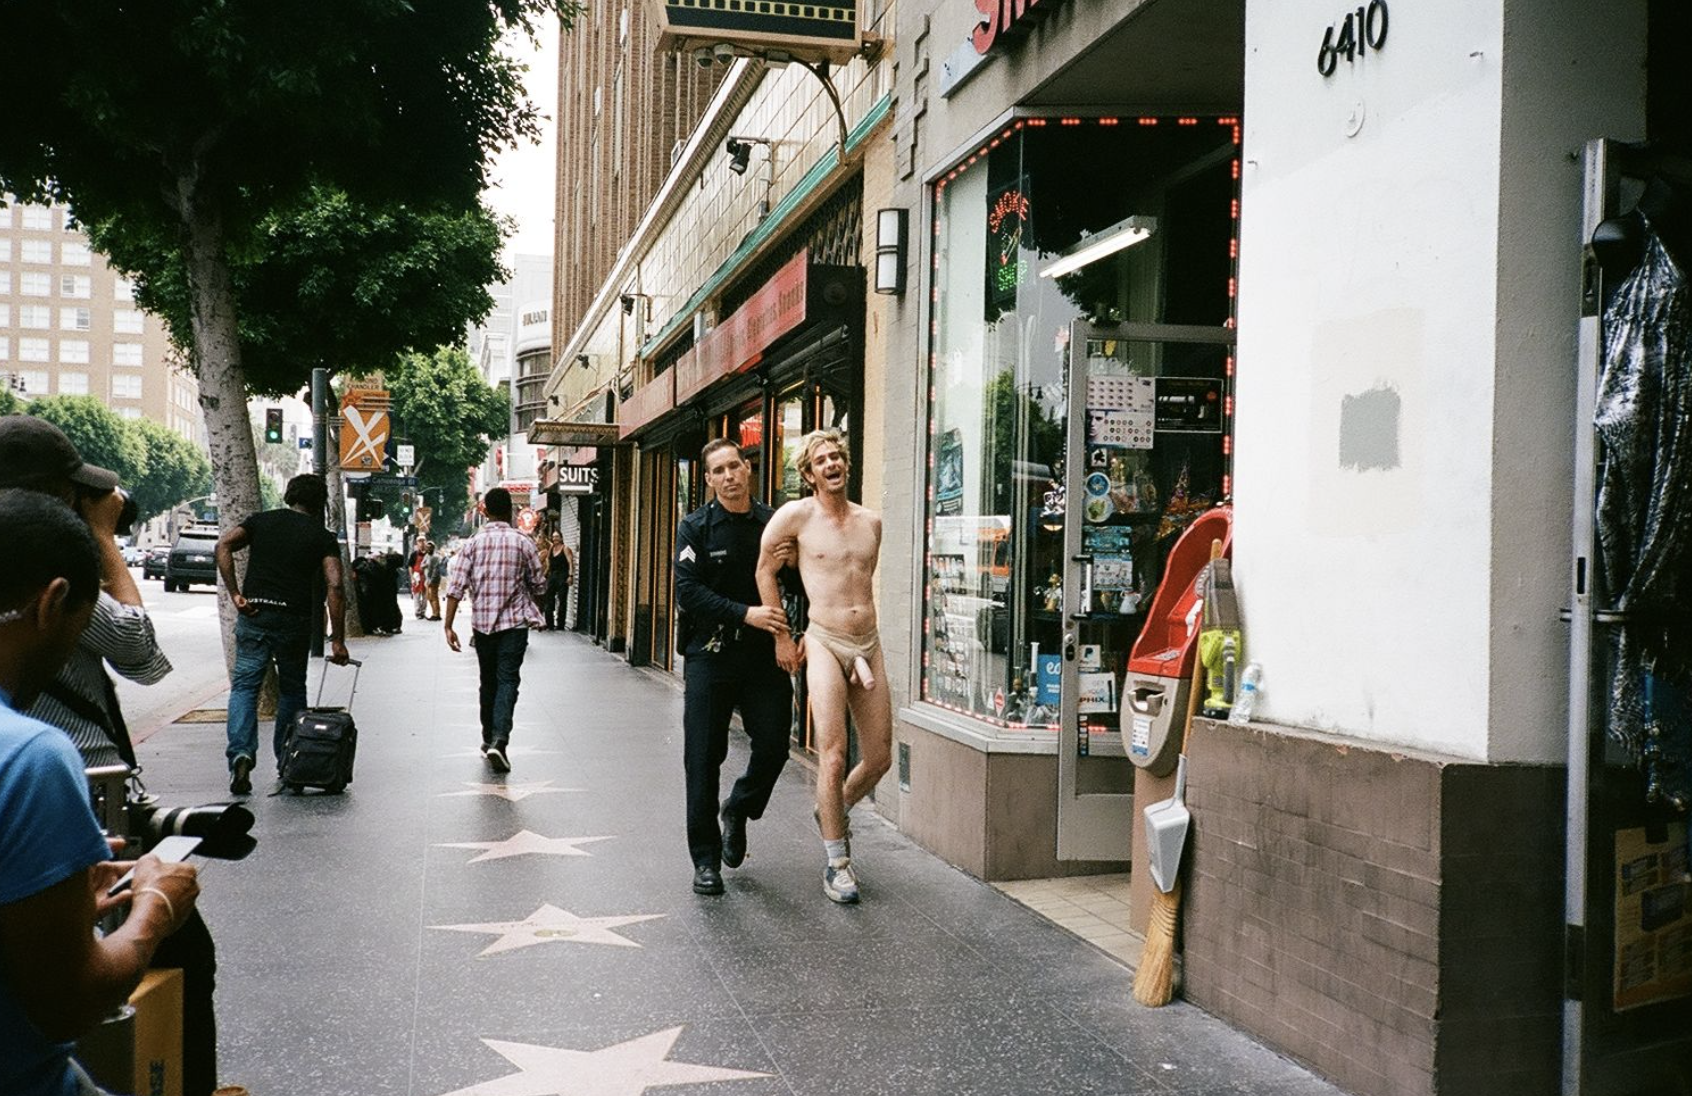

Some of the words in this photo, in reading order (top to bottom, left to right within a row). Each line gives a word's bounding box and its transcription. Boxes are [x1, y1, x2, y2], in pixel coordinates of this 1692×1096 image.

[1317, 0, 1389, 78] 6410
[990, 191, 1029, 234] SMOKE
[560, 467, 599, 483] SUITS
[247, 598, 287, 606] USTRALIA
